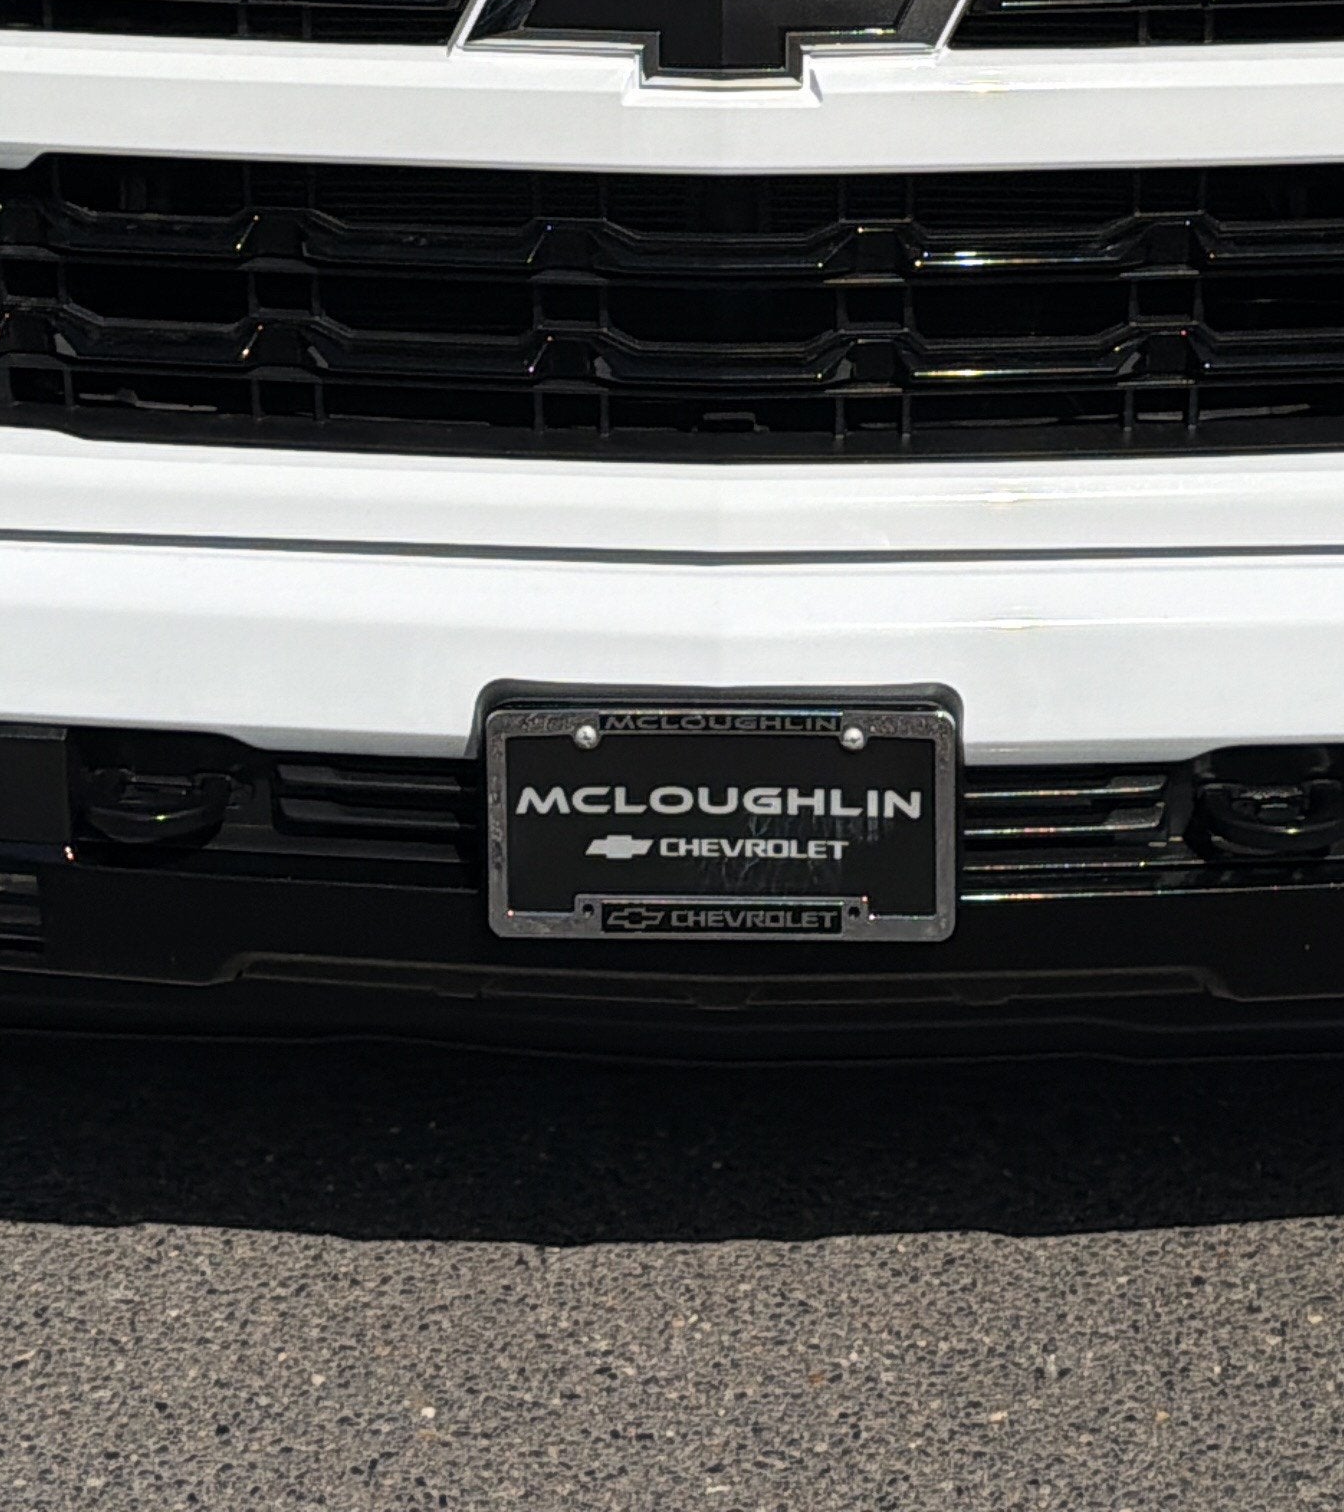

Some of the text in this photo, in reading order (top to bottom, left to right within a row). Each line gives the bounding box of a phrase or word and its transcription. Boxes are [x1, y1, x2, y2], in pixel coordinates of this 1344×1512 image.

[604, 715, 838, 732] MCLOUGHLIN
[515, 786, 922, 820] MCLOUGHLIN
[660, 837, 849, 860] CHEVROLET
[671, 909, 838, 929] CHEVROLET
